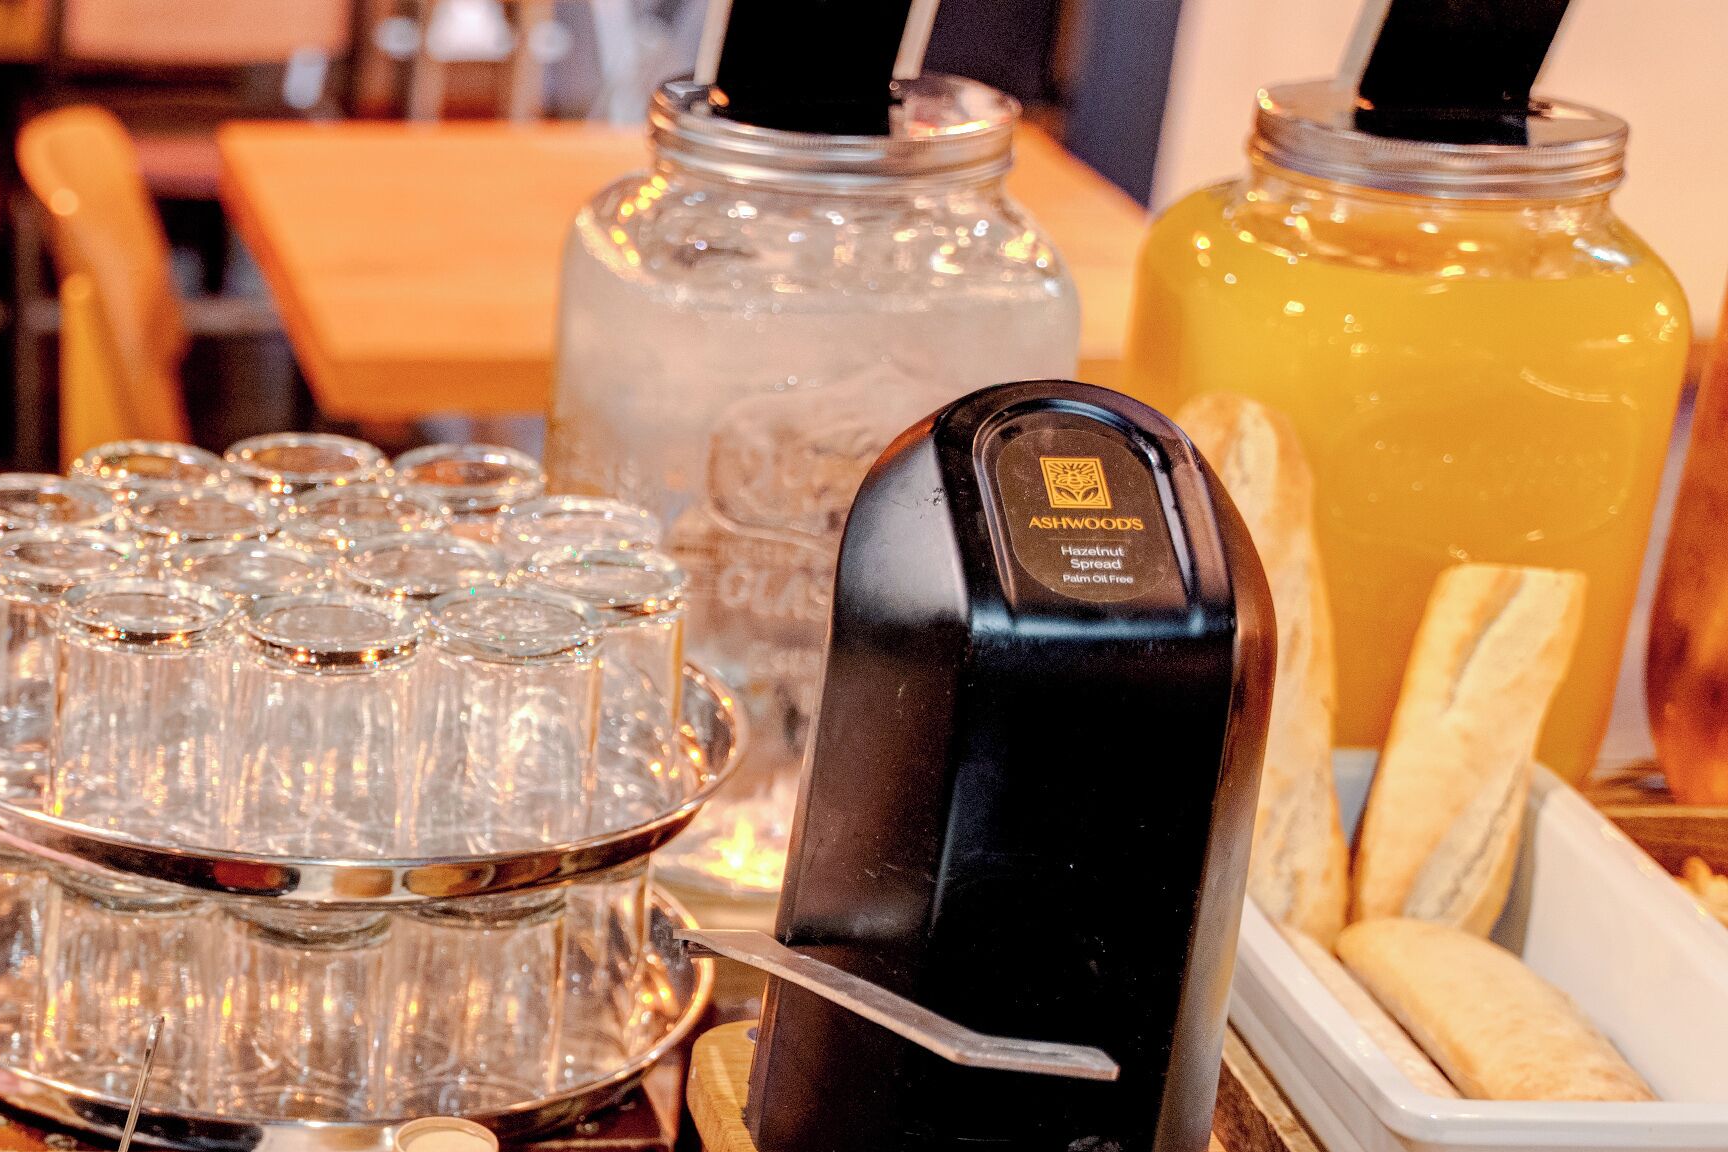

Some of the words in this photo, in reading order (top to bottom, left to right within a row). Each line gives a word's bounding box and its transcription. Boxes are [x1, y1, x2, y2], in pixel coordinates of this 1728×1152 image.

[1028, 516, 1144, 530] ASHWOOD'S
[1060, 545, 1125, 557] Hazelnut
[1070, 559, 1121, 571] Spread
[1062, 574, 1091, 583] Palm
[1092, 574, 1107, 584] Oil
[1109, 574, 1134, 584] Free
